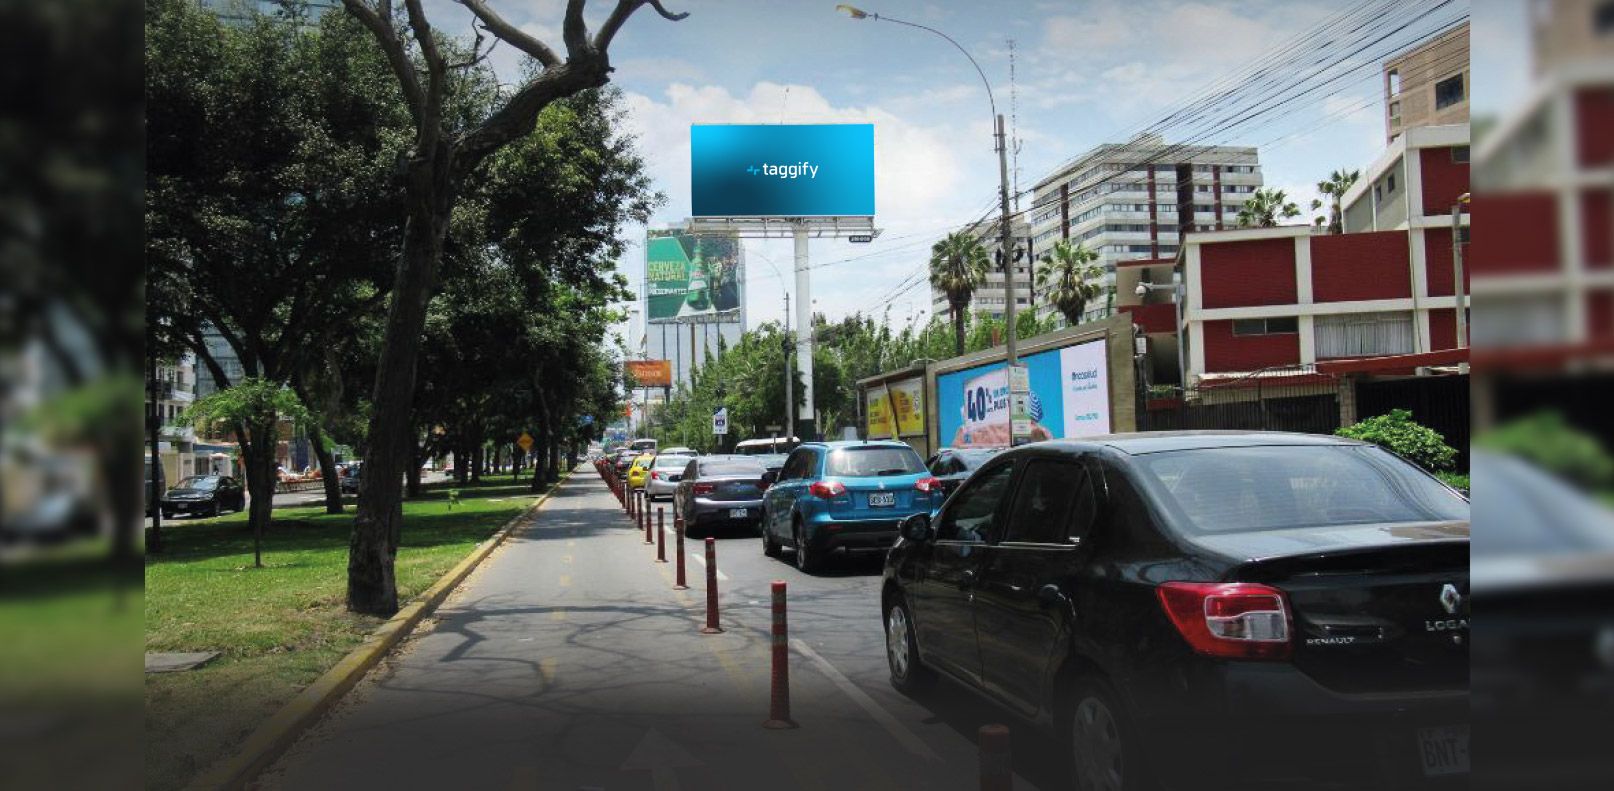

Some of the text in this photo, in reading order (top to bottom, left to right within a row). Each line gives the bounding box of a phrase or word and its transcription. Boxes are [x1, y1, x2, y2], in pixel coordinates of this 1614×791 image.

[762, 161, 819, 179] taggify
[648, 260, 686, 272] CERVEZA
[1425, 619, 1470, 632] LOGA
[1306, 636, 1355, 645] RENAULT
